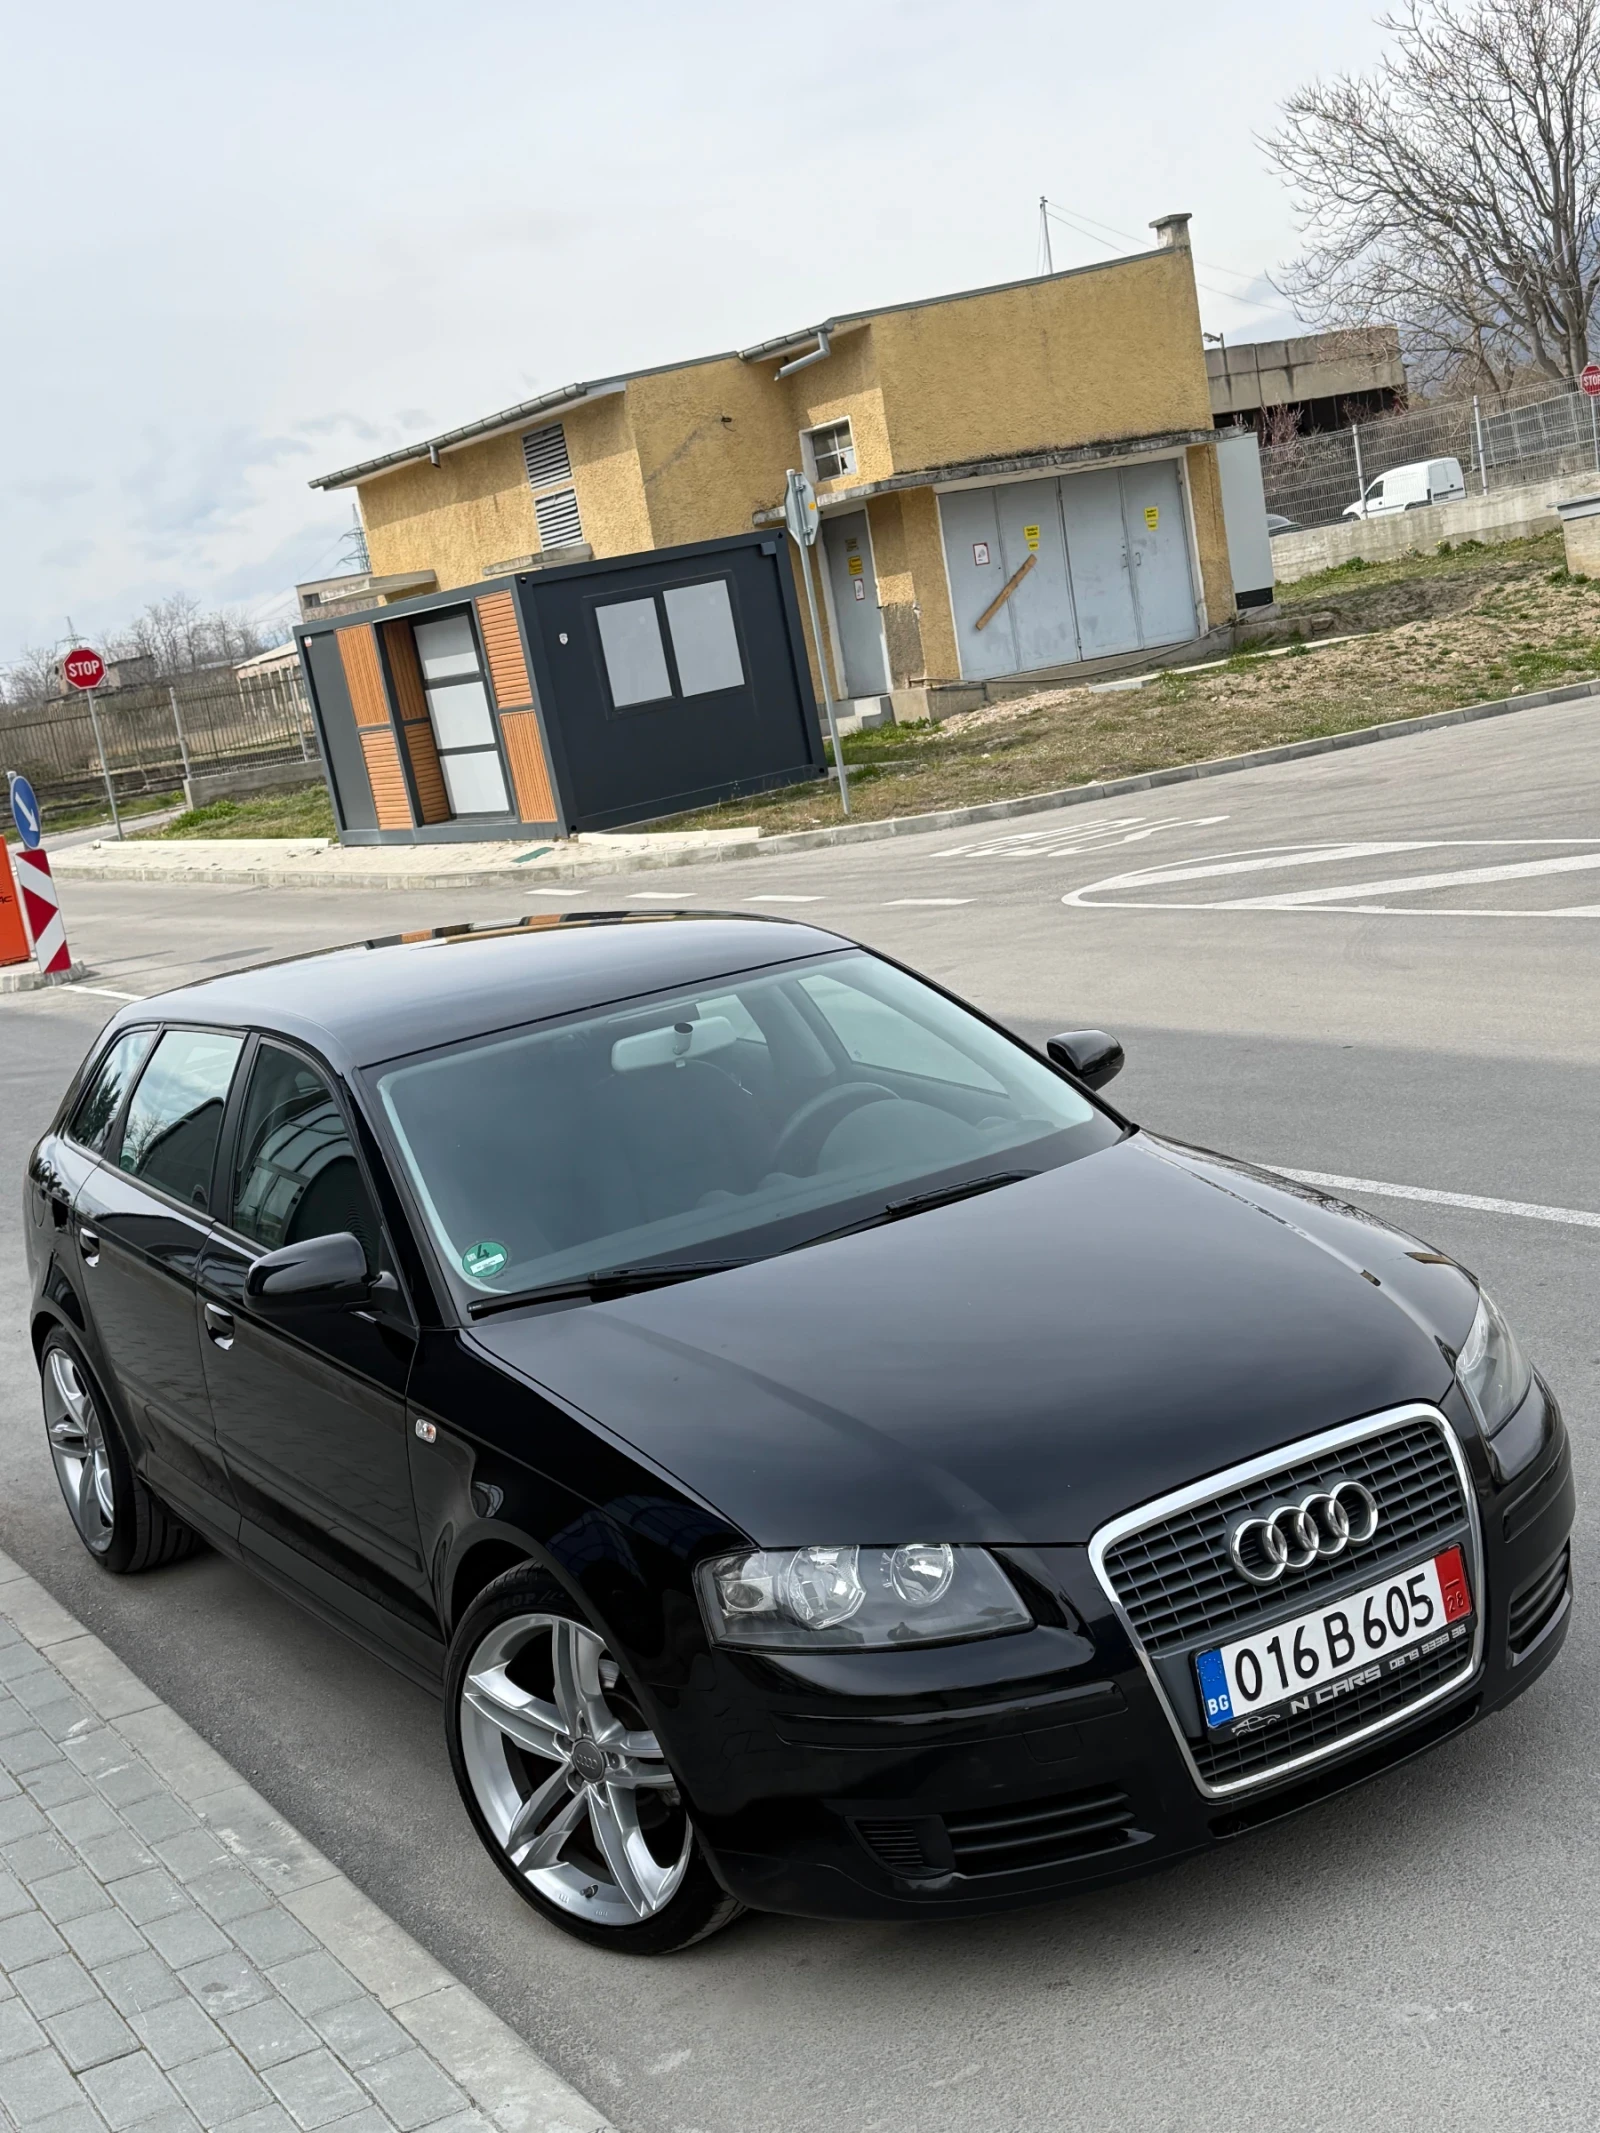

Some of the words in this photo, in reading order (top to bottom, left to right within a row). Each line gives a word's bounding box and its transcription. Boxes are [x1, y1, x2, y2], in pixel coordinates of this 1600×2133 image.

[68, 660, 100, 677] STOP
[1446, 1590, 1464, 1613] 28
[1290, 1697, 1309, 1715] N
[1315, 1665, 1381, 1705] CARS
[1389, 1648, 1419, 1671] 0879
[1207, 1695, 1229, 1716] BG
